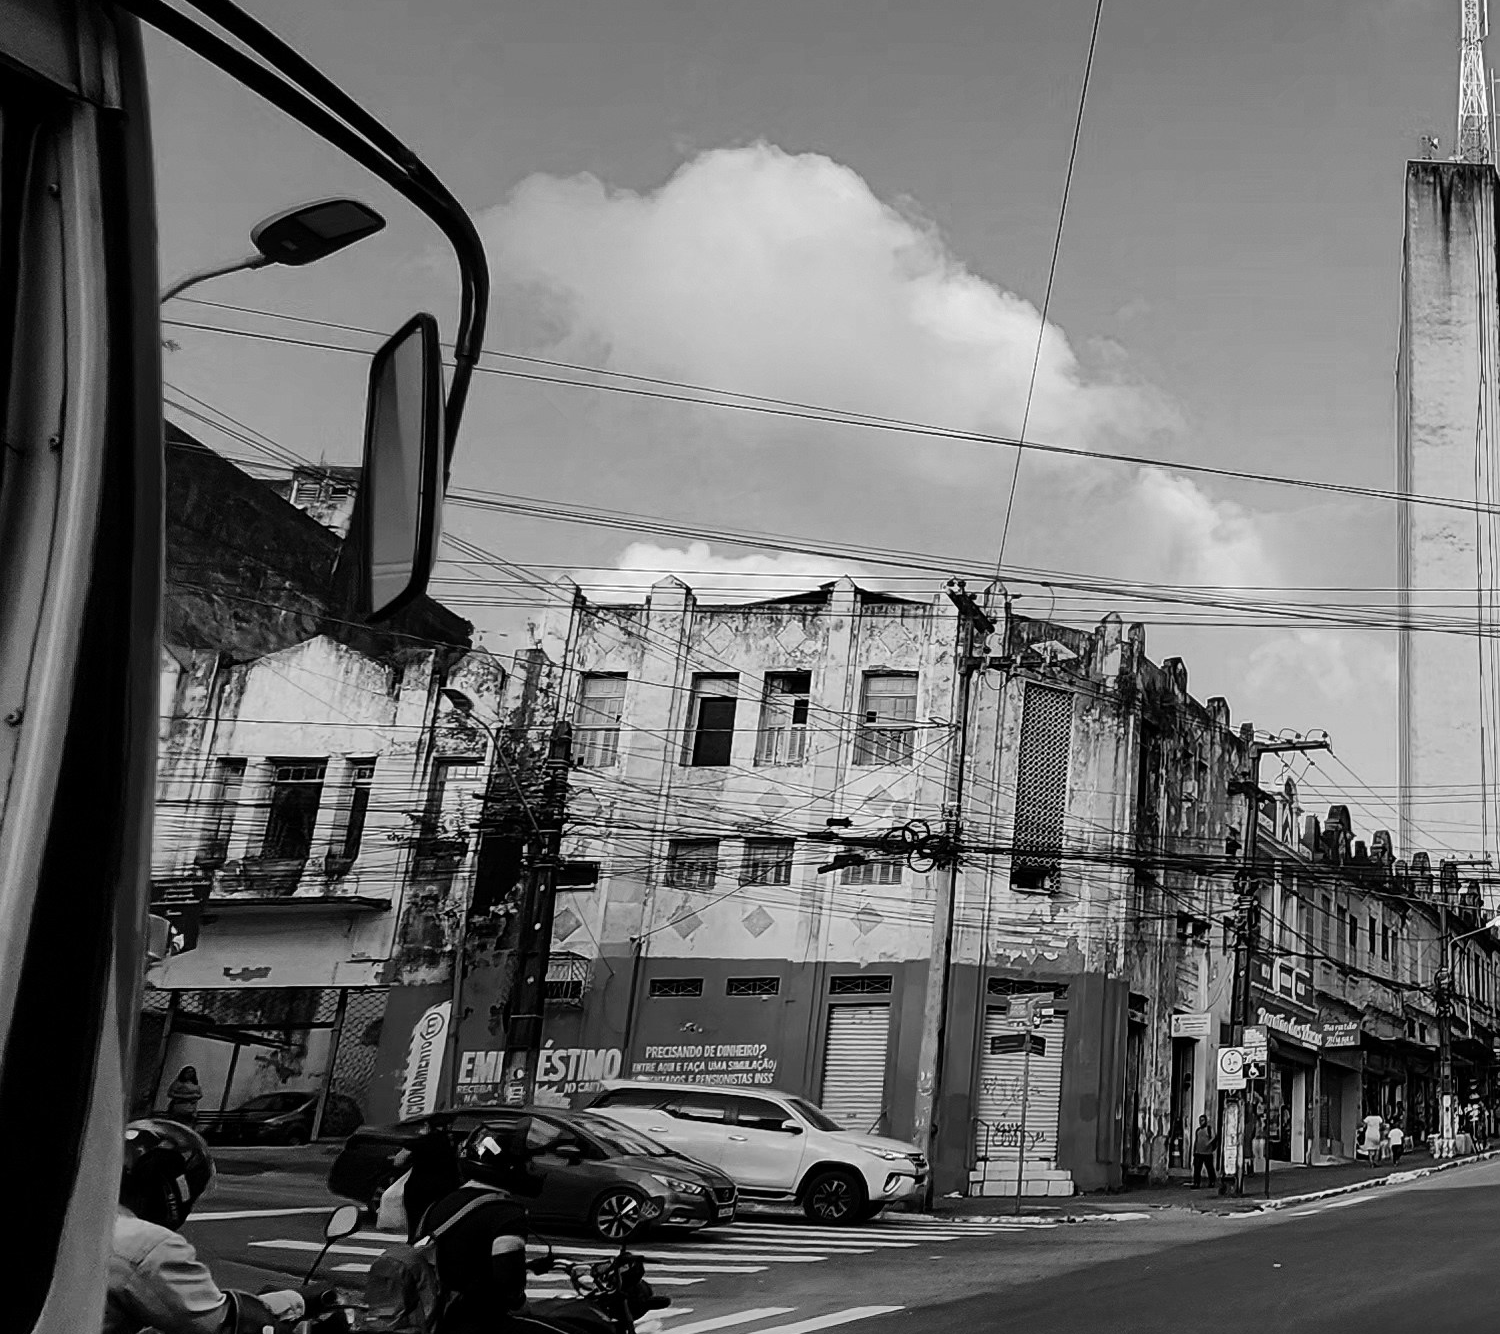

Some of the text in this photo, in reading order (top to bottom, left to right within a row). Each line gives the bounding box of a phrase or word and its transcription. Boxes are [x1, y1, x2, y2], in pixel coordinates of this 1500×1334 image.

[645, 1044, 767, 1059] PRECISANDO DE DINHEIRO?
[632, 1062, 657, 1072] ENTRE
[657, 1062, 675, 1074] AQUI
[676, 1062, 682, 1072] E
[683, 1061, 706, 1073] FAÇA
[708, 1060, 727, 1071] UMA
[754, 1072, 774, 1084] INSS
